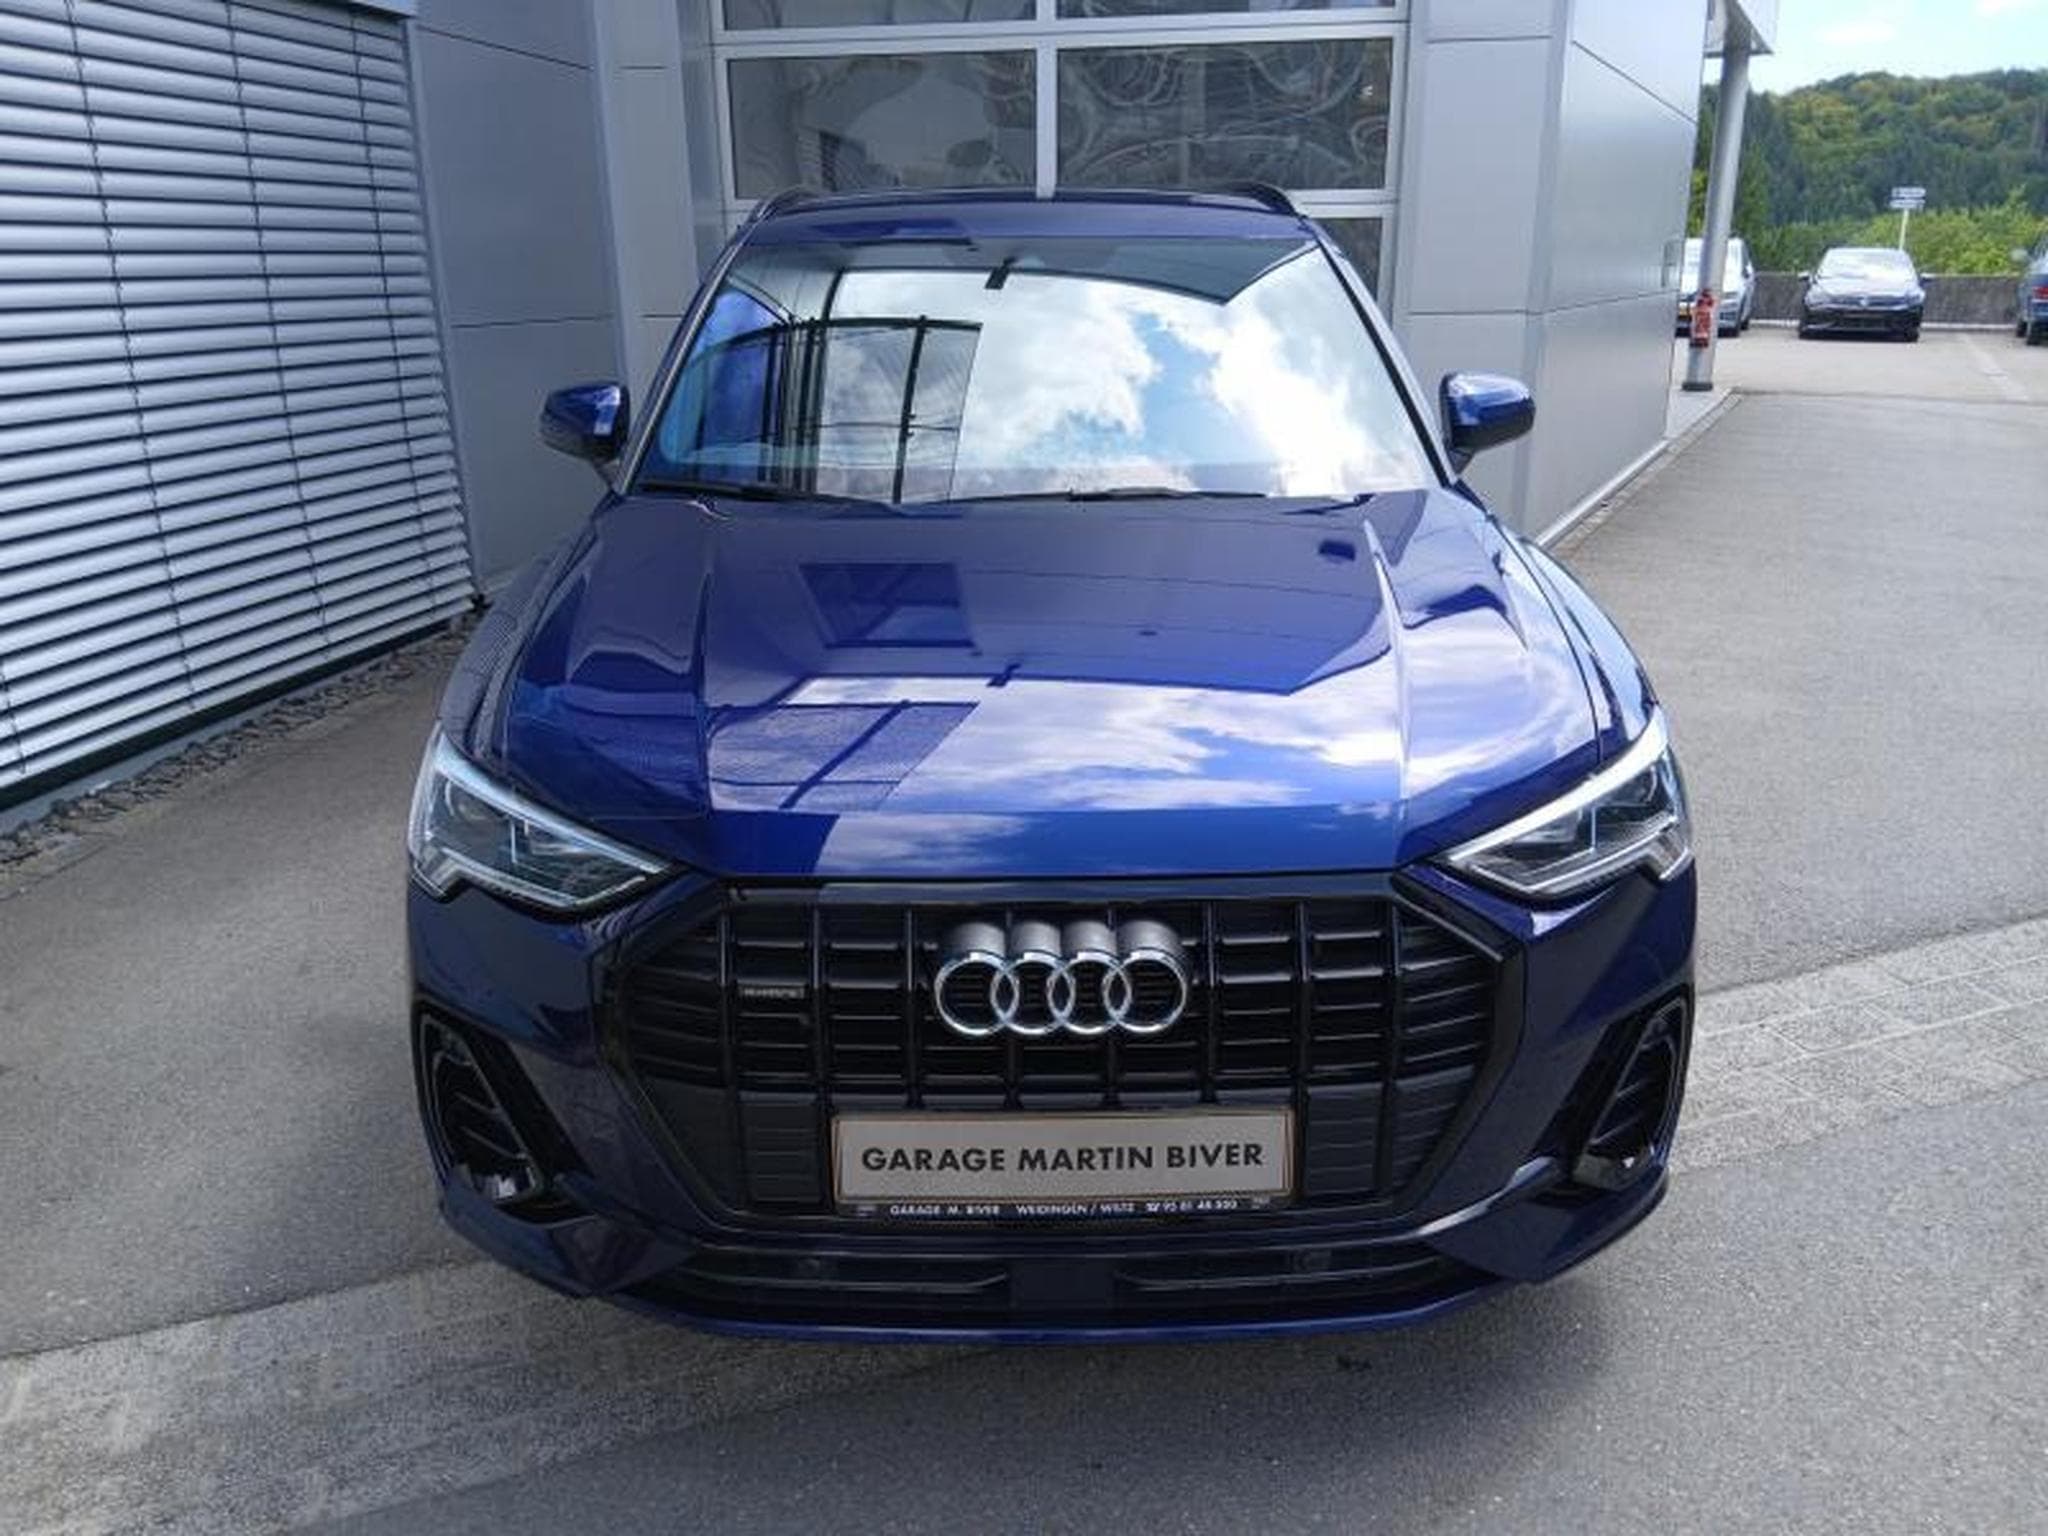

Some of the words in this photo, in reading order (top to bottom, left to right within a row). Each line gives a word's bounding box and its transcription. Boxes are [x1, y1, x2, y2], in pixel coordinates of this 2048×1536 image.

[862, 1147, 1005, 1172] GARAGE
[1018, 1146, 1153, 1171] MARTIN
[1166, 1143, 1264, 1168] BIVER
